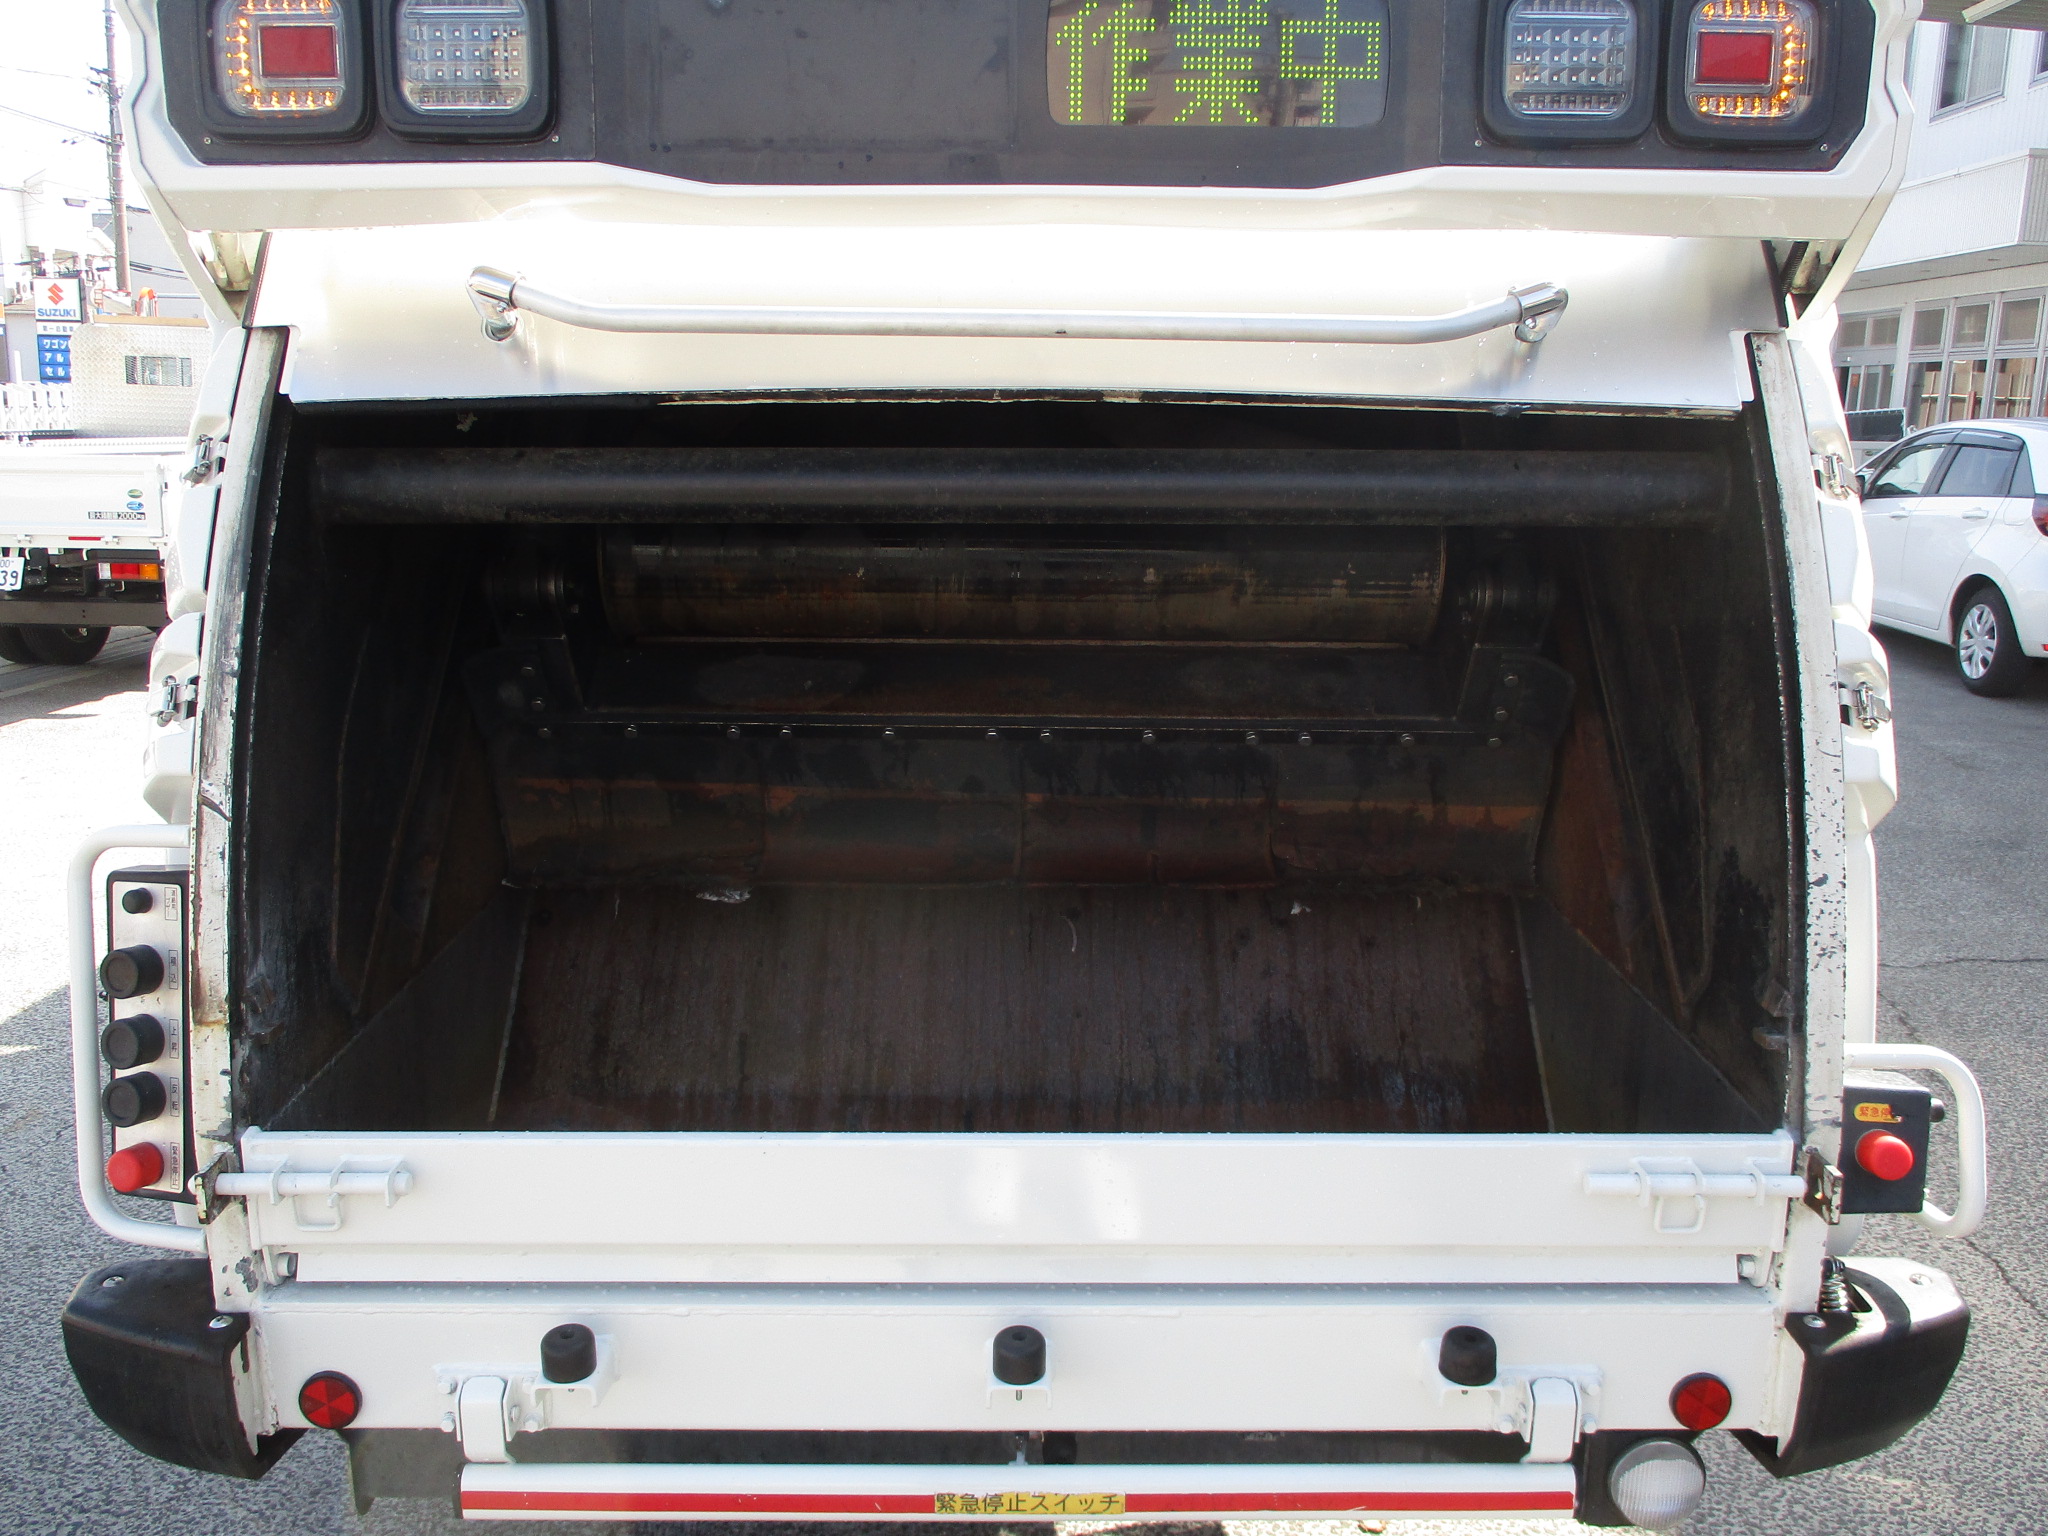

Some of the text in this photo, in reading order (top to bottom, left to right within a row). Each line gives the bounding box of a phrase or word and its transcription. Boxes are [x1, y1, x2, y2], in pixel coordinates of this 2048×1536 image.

[1056, 0, 1382, 122] 作業中
[37, 308, 76, 317] SUZUKI
[43, 339, 70, 349] ワゴン
[0, 570, 18, 586] 39
[936, 1492, 1120, 1513] 緊急停止スイッチ
